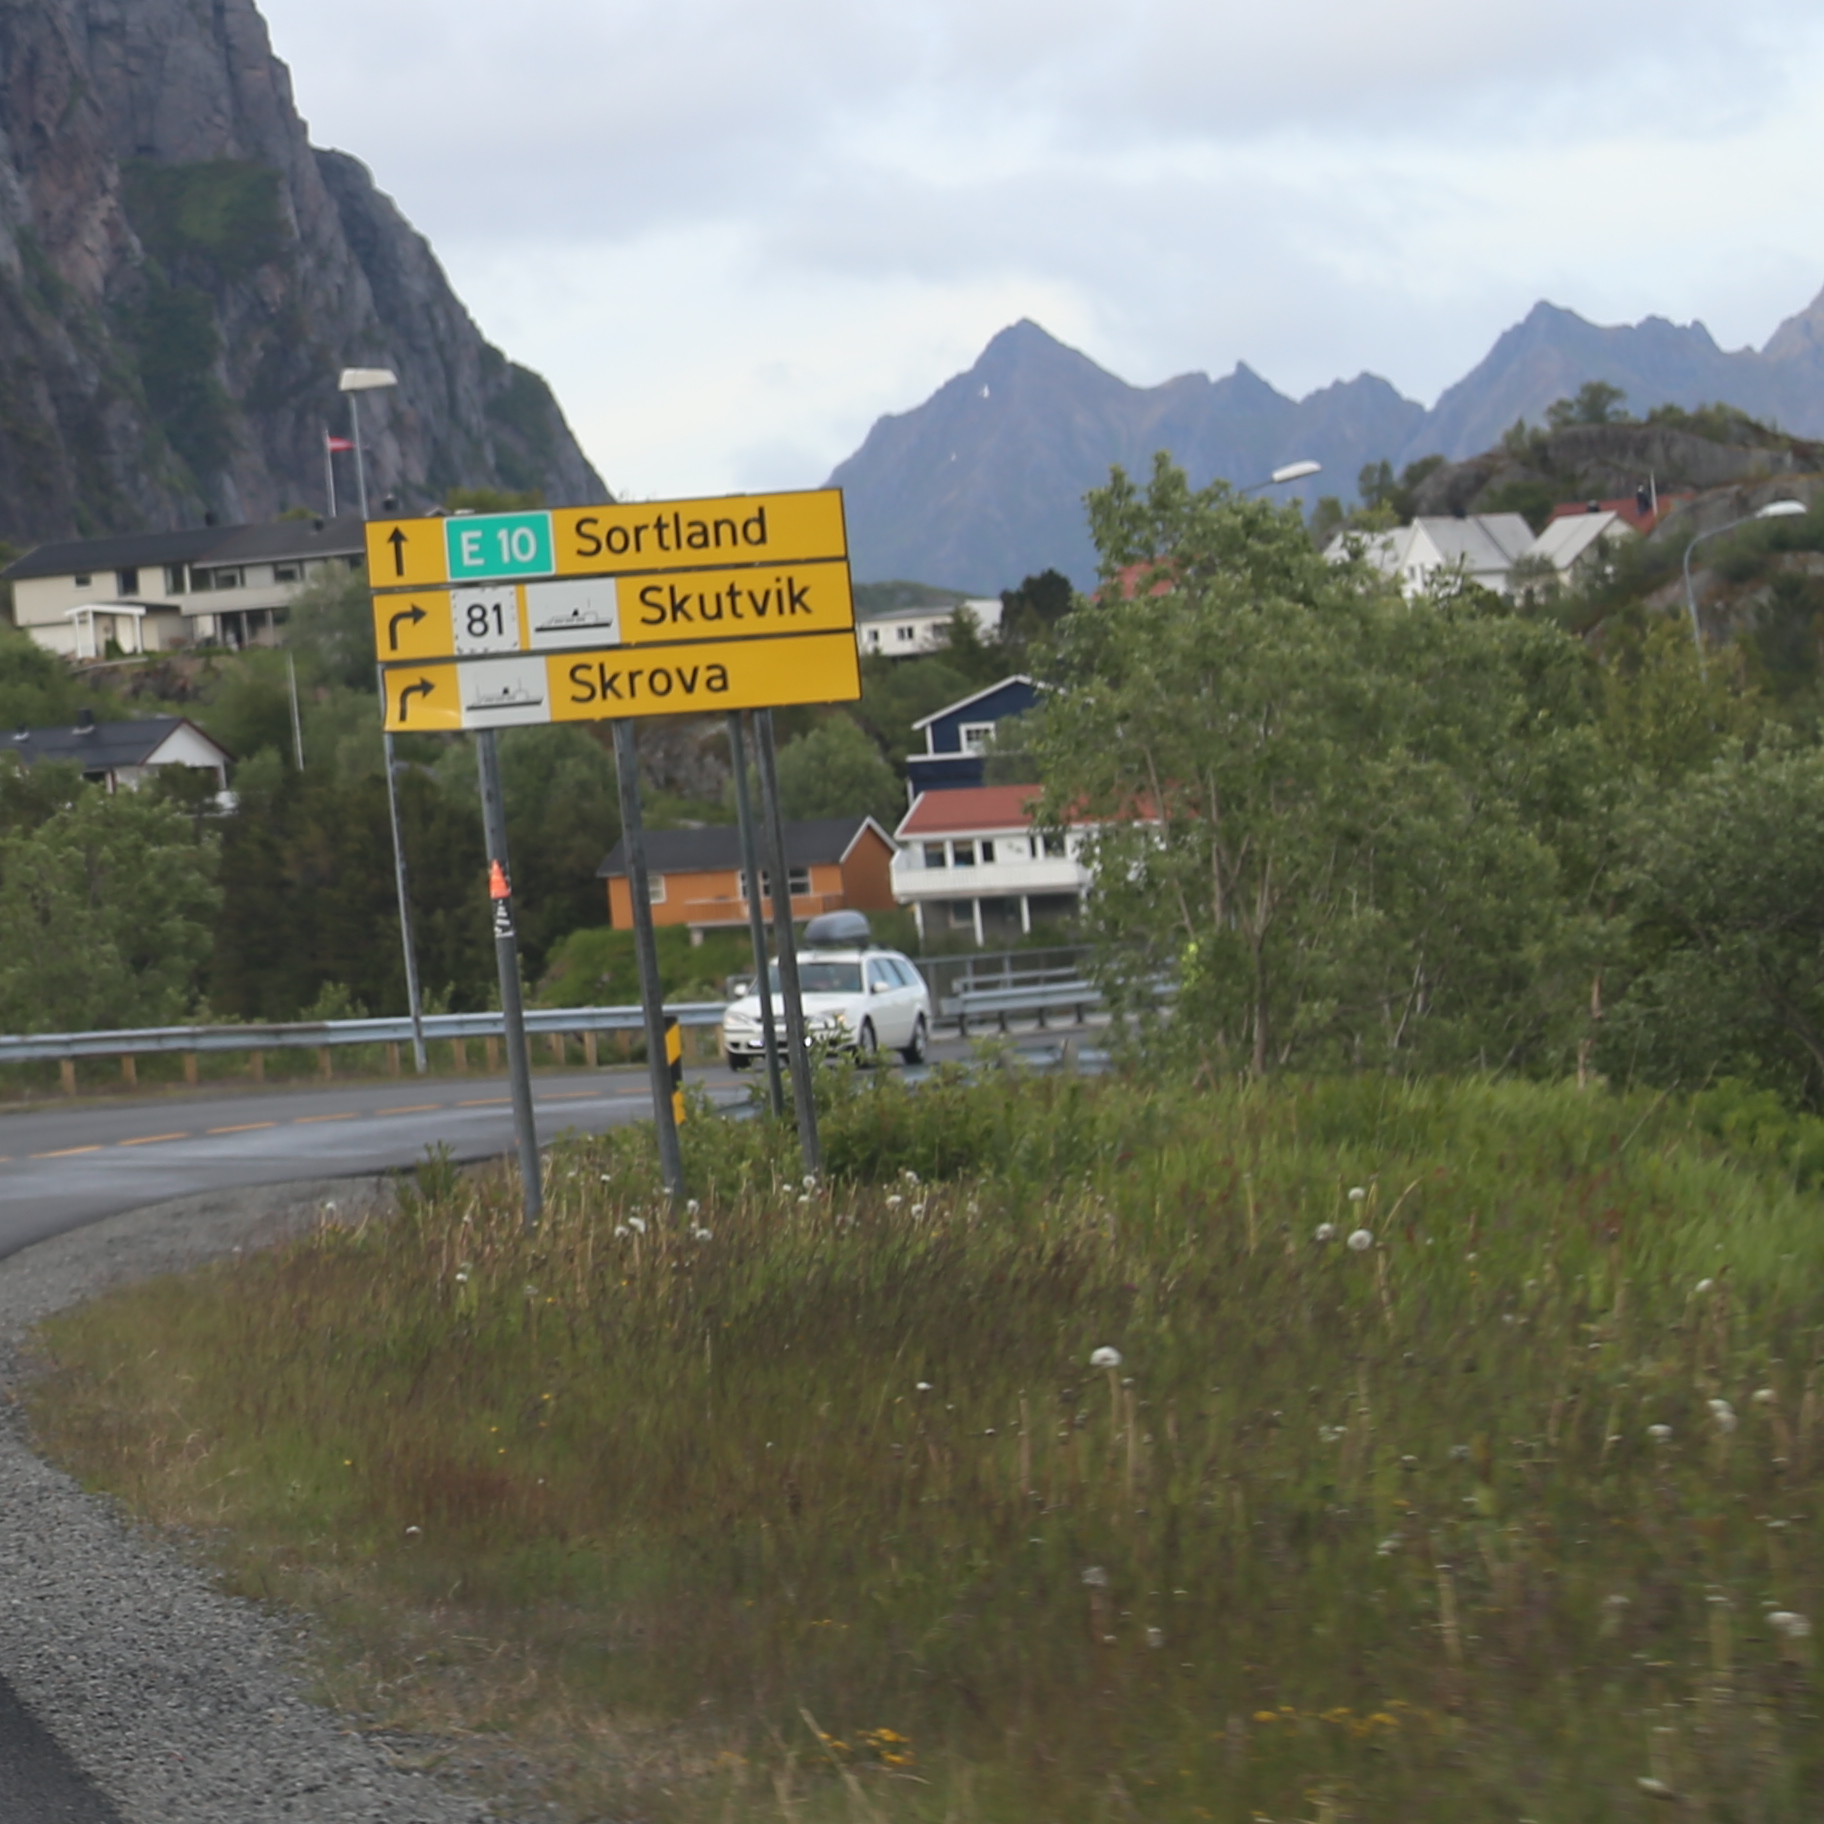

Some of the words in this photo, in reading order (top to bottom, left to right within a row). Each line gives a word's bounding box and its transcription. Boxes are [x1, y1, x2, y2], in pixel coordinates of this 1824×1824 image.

[459, 529, 485, 567] E
[496, 526, 538, 564] 10
[574, 506, 769, 558] Sortland
[465, 603, 504, 638] 81
[639, 577, 813, 625] Skutvik
[568, 661, 730, 704] Skrova
